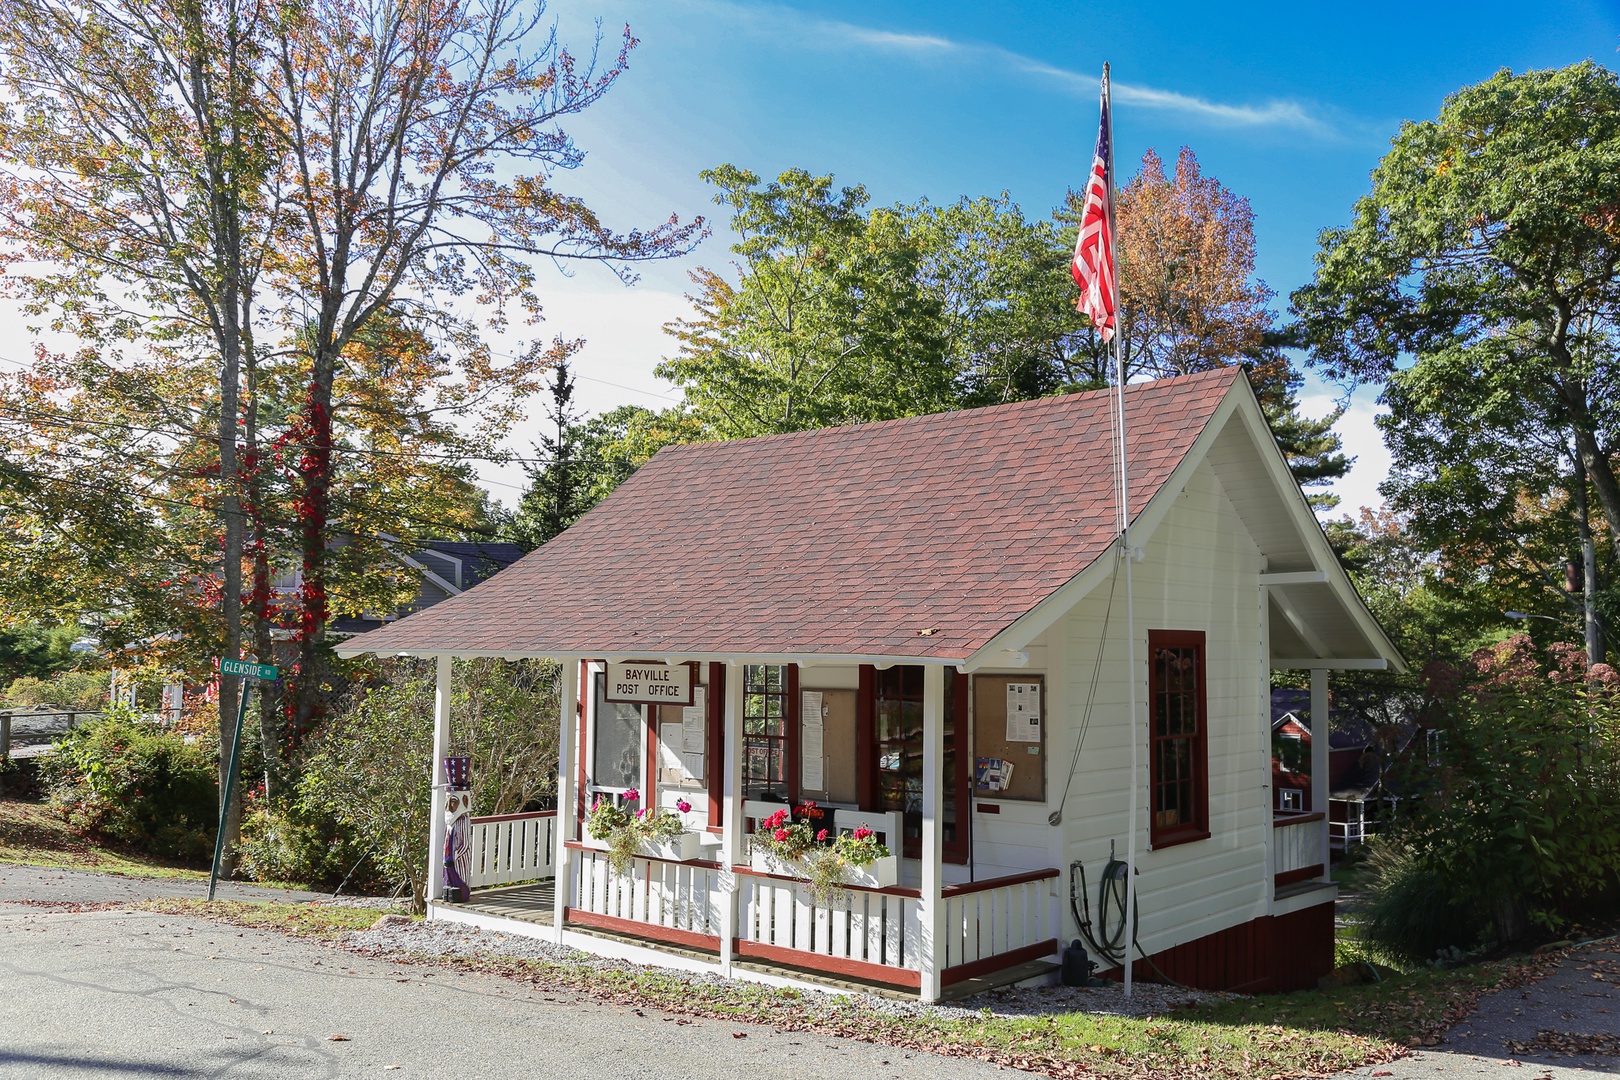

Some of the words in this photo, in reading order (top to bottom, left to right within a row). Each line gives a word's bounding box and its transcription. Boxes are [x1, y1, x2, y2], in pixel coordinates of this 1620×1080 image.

[224, 661, 262, 676] GLENSIDE
[625, 669, 670, 681] BAYVILLE
[616, 683, 639, 694] POST
[648, 684, 679, 696] OFFICE
[759, 748, 778, 756] OFFCE
